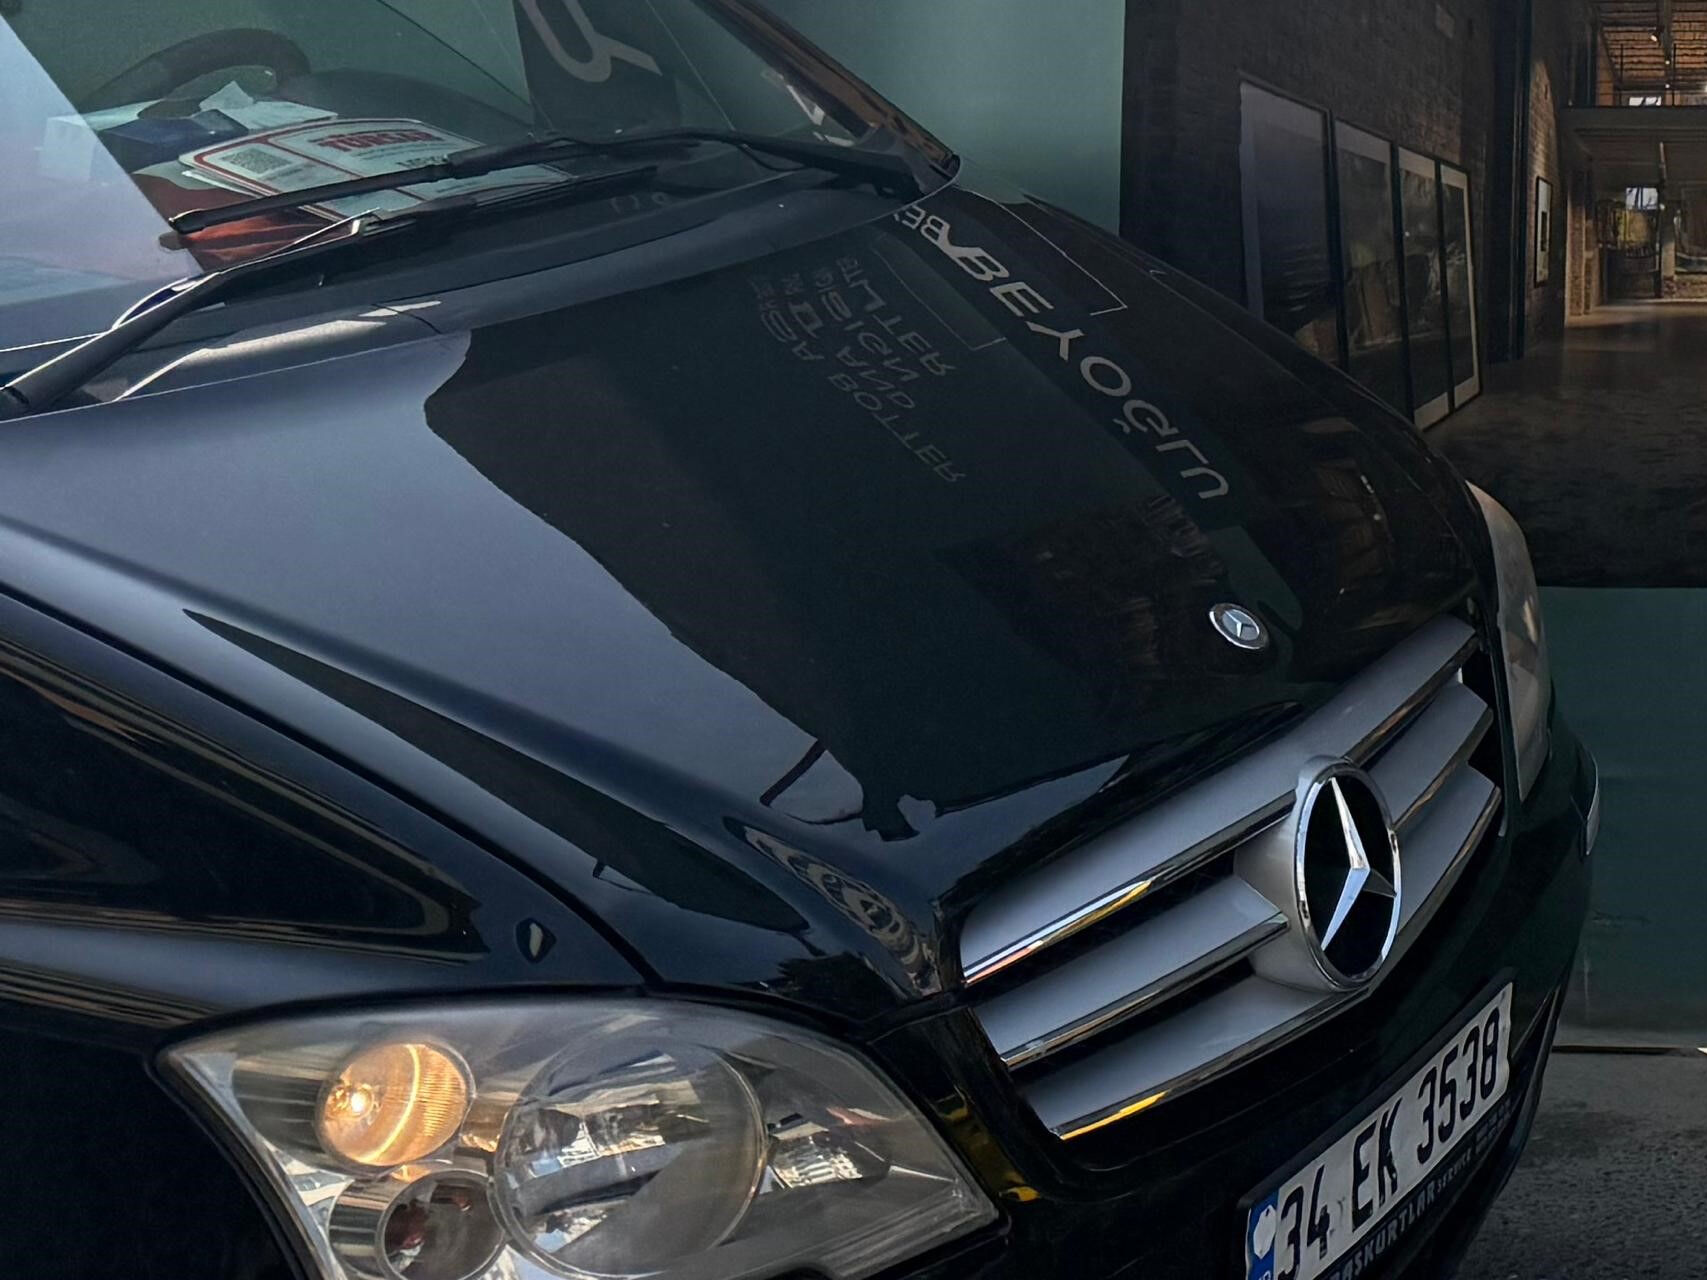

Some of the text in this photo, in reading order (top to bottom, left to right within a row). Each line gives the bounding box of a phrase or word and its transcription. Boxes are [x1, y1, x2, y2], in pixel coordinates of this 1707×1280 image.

[1278, 1163, 1331, 1280] 34
[1351, 1096, 1402, 1233] EK
[1416, 1006, 1500, 1166] 3538
